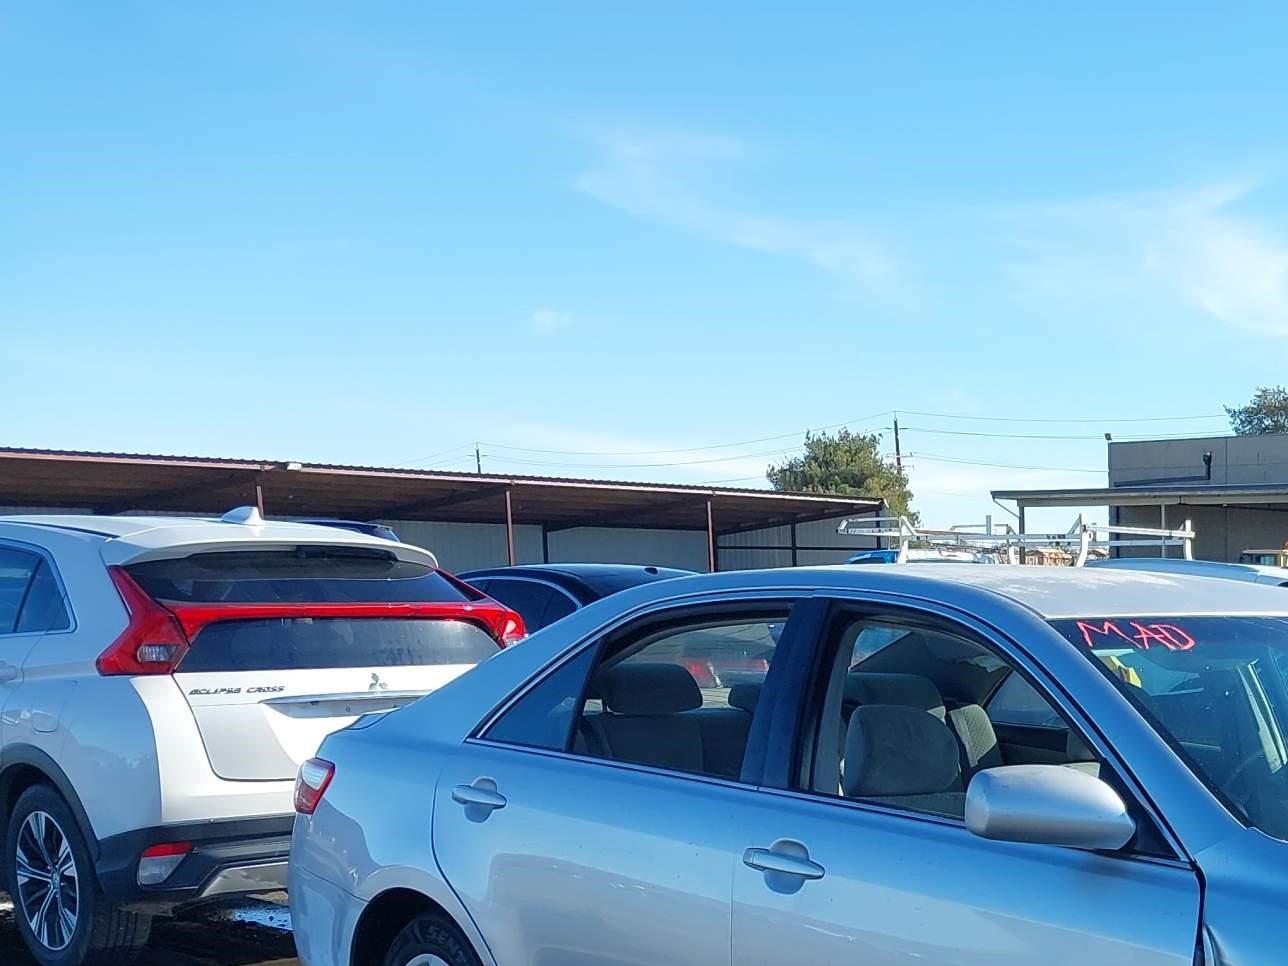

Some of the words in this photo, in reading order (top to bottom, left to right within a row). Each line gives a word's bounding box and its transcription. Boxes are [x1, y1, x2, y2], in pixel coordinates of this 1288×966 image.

[1076, 620, 1195, 650] MAD
[188, 687, 242, 696] ECLIPSE
[246, 685, 285, 694] CROSS
